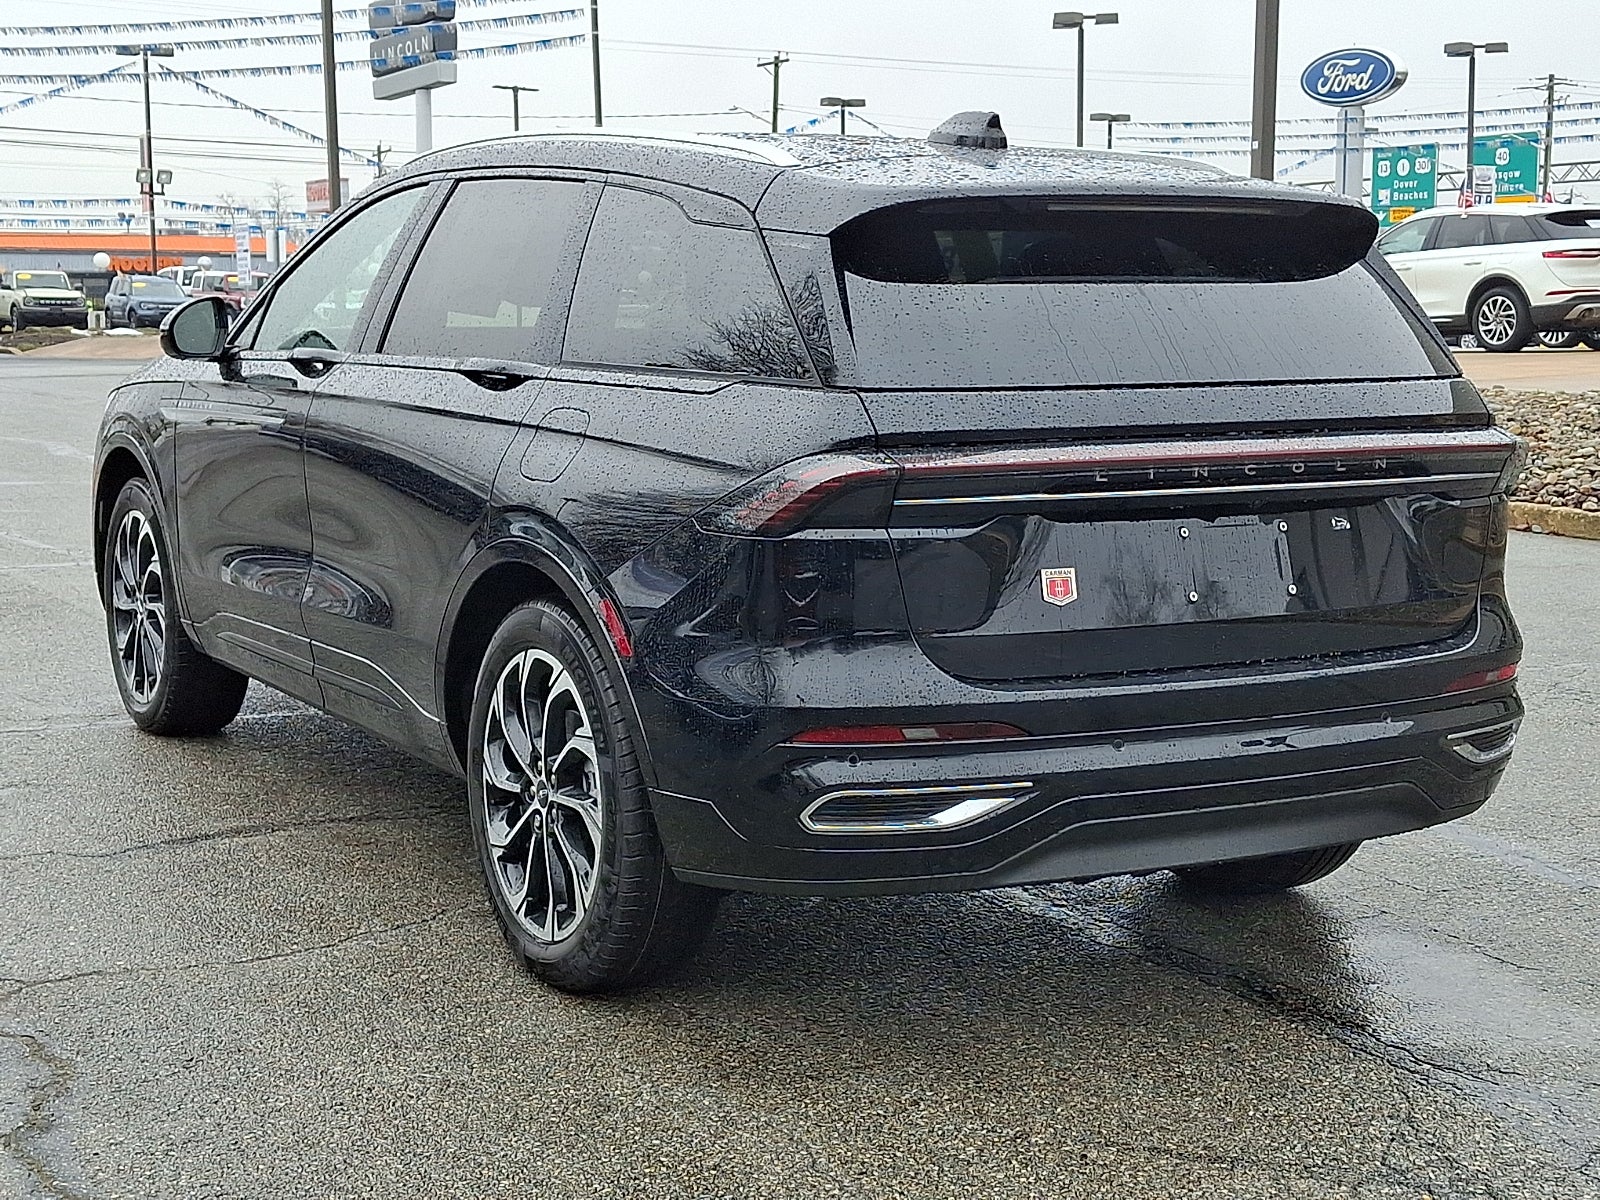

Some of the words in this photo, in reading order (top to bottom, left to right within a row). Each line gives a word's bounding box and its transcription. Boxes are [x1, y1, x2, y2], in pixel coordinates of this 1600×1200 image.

[1317, 58, 1374, 94] Ford
[1496, 151, 1508, 161] 40
[1380, 163, 1388, 174] 13
[1393, 180, 1418, 189] Dover
[1393, 191, 1428, 201] Beaches
[1095, 458, 1387, 482] LINCOLN
[1045, 569, 1072, 577] CARMAN
